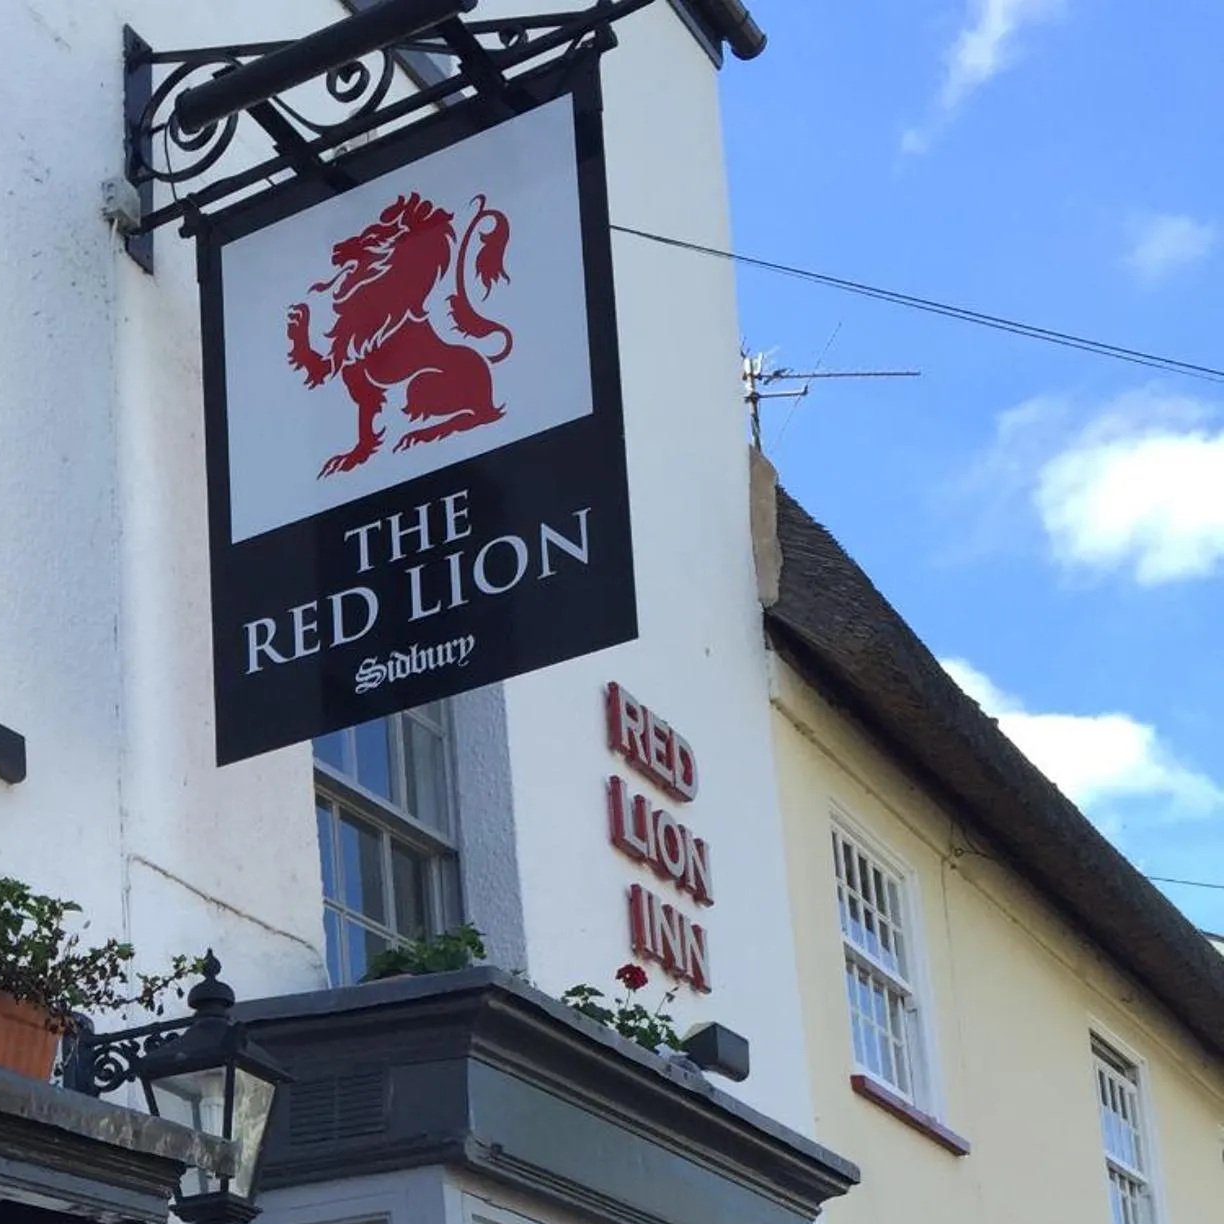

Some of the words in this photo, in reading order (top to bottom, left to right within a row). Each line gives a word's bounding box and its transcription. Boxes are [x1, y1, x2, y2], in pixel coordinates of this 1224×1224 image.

[344, 489, 473, 574] THE
[243, 585, 379, 675] RED
[405, 506, 592, 622] LION
[354, 633, 476, 695] Sidbury
[607, 680, 698, 802] RED
[608, 775, 714, 907] LION
[628, 883, 712, 994] INN
